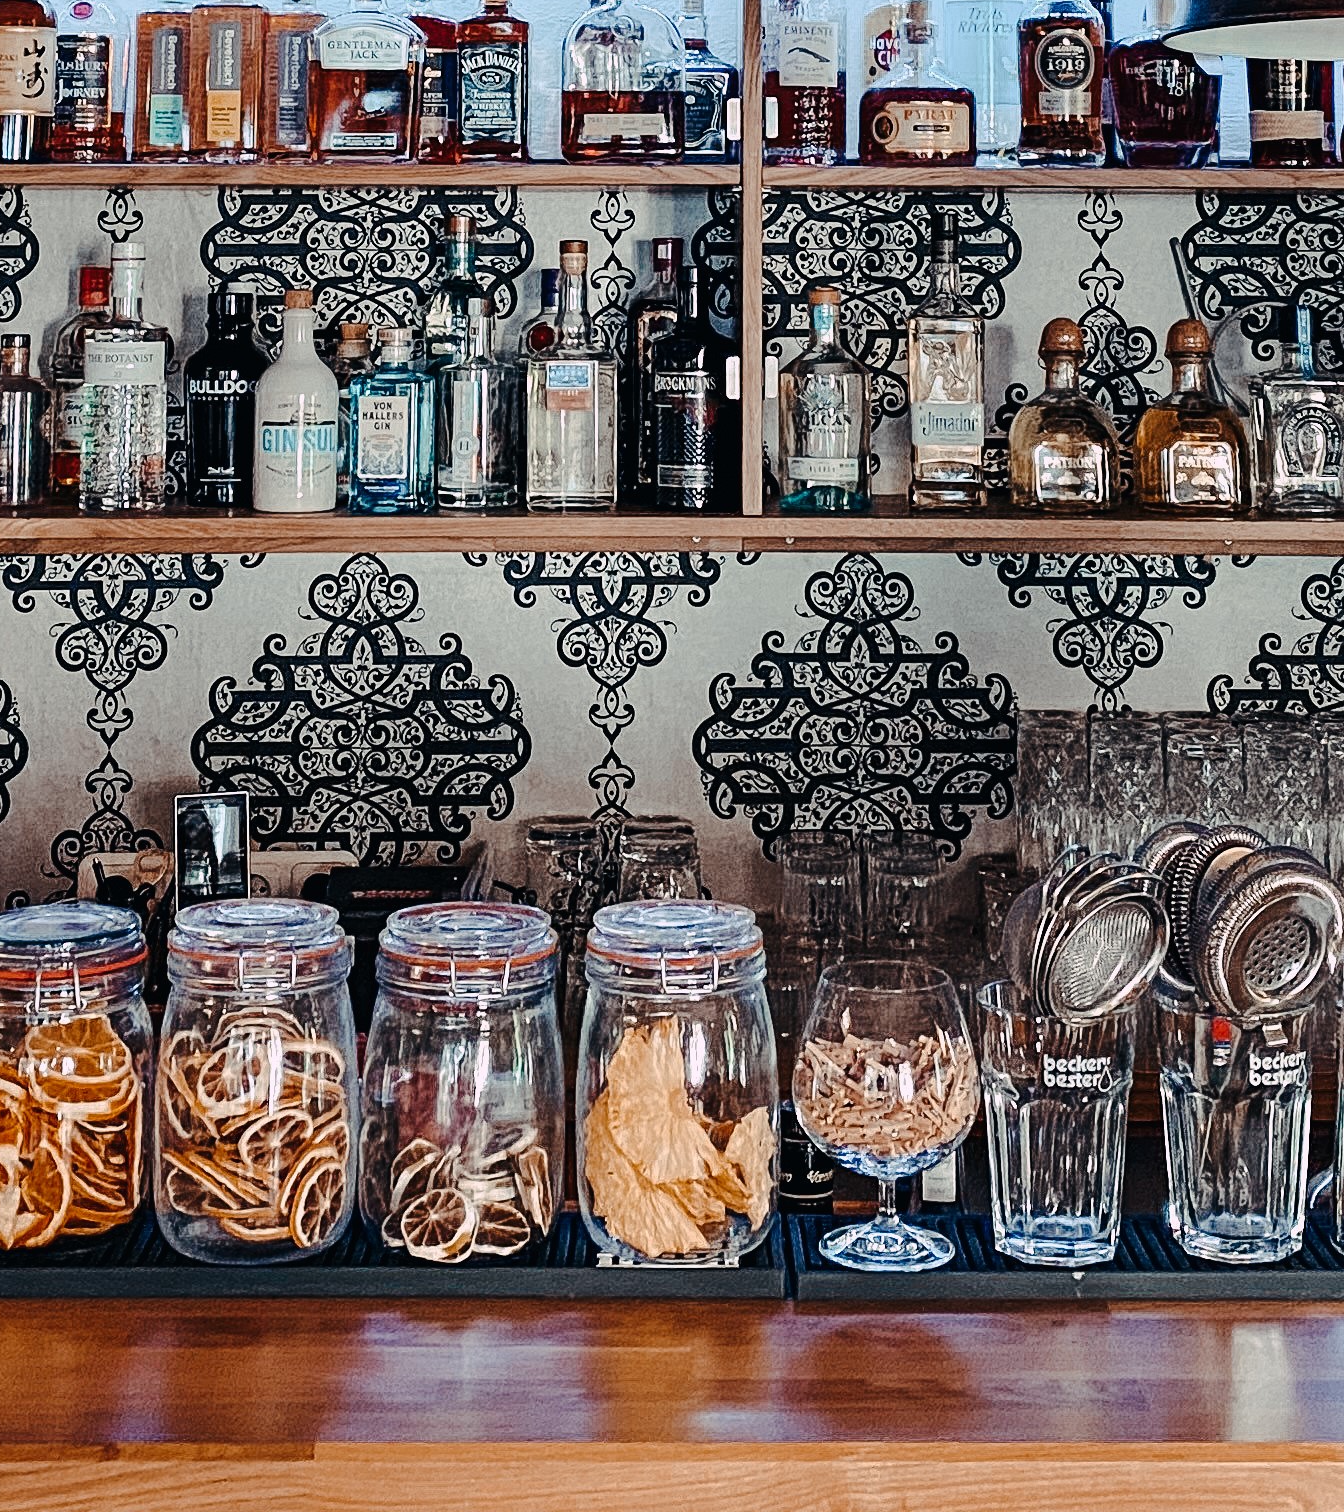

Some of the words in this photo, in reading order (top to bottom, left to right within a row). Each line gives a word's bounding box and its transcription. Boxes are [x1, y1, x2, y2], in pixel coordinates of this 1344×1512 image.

[327, 41, 401, 50] GENTLEMAN
[350, 50, 379, 60] JACK
[1046, 59, 1085, 71] 1919
[88, 354, 103, 363] THE
[105, 353, 154, 364] BOTANIST
[373, 402, 392, 410] VON
[362, 411, 404, 420] HALLERS
[374, 422, 391, 430] GIN
[262, 427, 297, 452] GIN
[1044, 1071, 1099, 1088] bester
